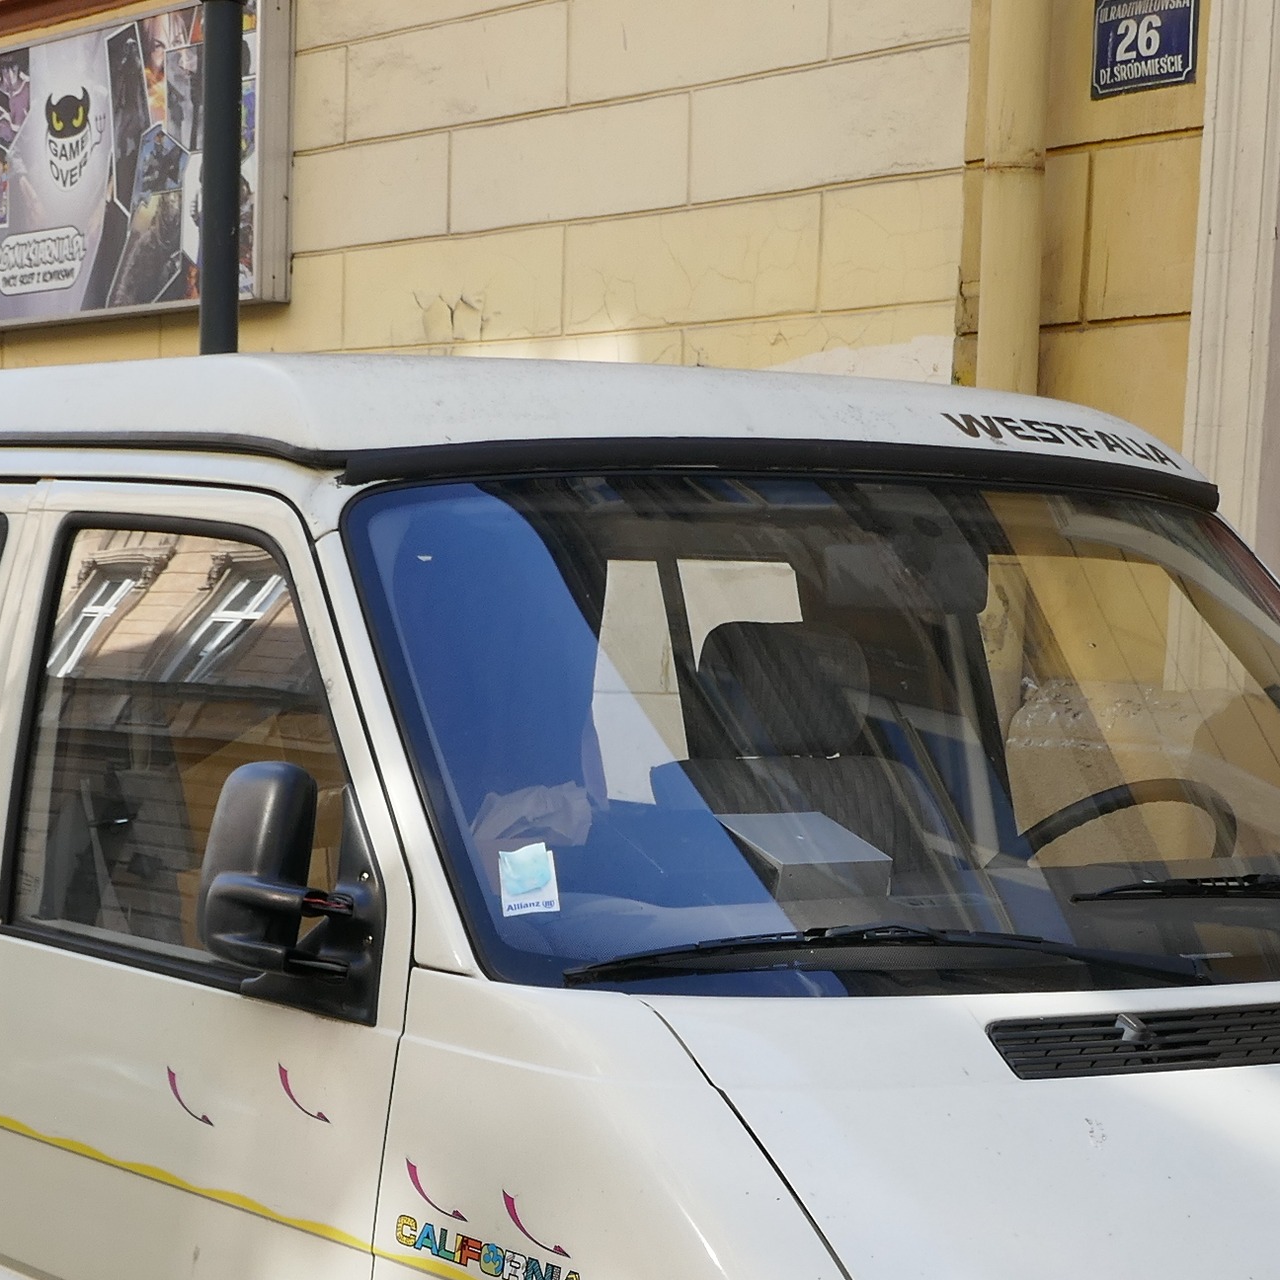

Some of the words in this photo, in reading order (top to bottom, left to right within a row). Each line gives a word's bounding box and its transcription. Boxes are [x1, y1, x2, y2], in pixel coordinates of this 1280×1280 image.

[1116, 14, 1161, 62] 26
[48, 132, 88, 161] GAME
[50, 152, 87, 188] OVER
[941, 413, 1182, 471] WESTFALIA
[506, 901, 541, 912] Allianz
